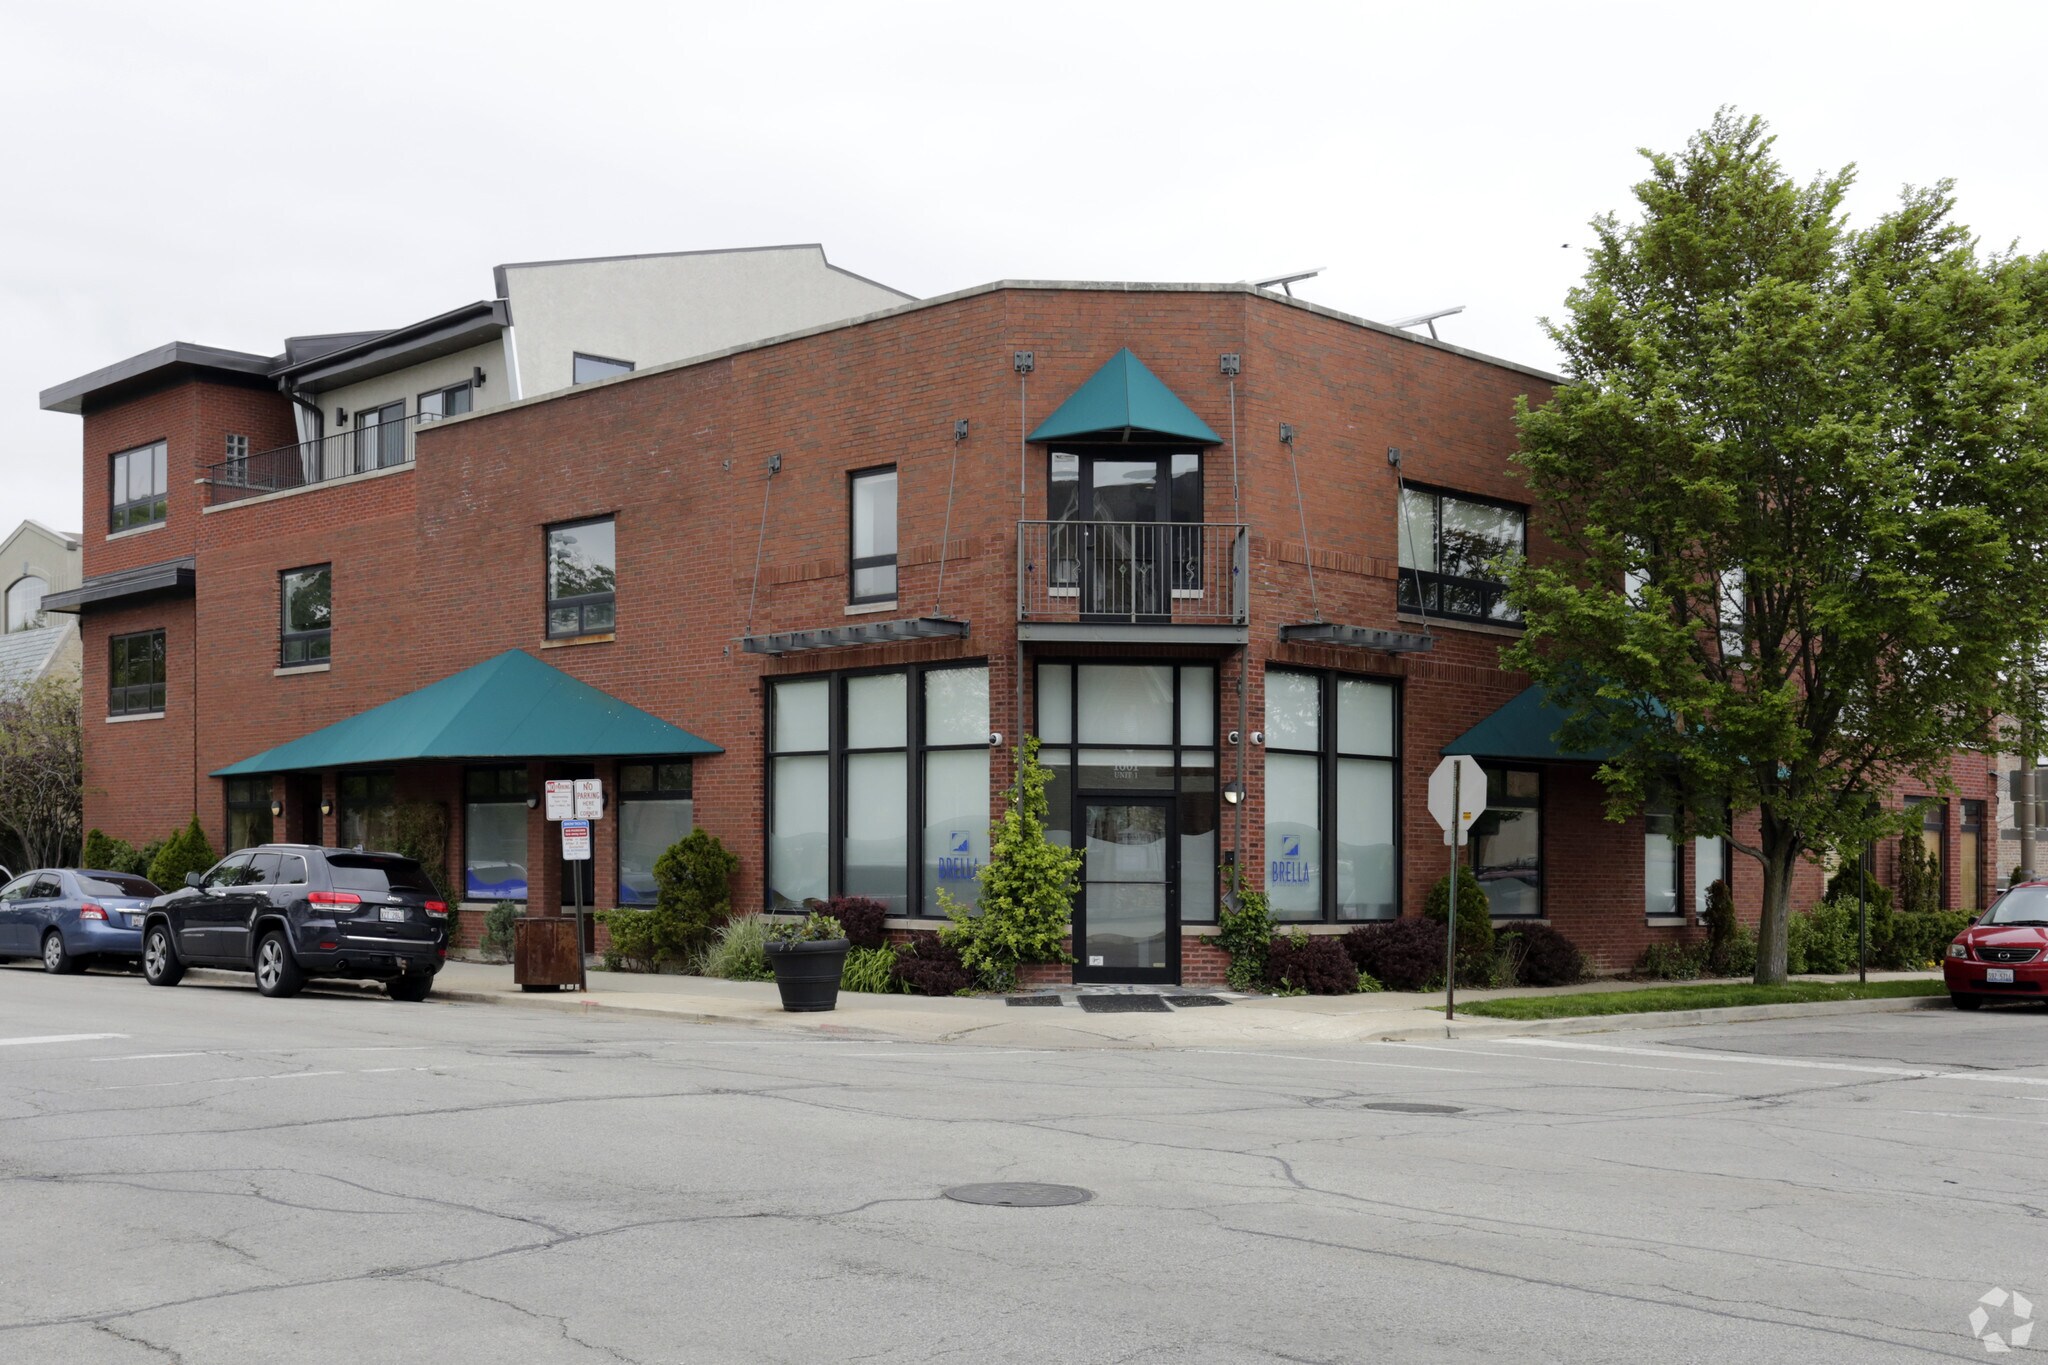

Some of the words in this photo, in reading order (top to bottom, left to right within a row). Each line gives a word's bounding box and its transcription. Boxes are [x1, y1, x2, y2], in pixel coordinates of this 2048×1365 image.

[1114, 771, 1132, 779] UNIT
[583, 783, 593, 791] NO
[1272, 861, 1310, 882] BRELLA
